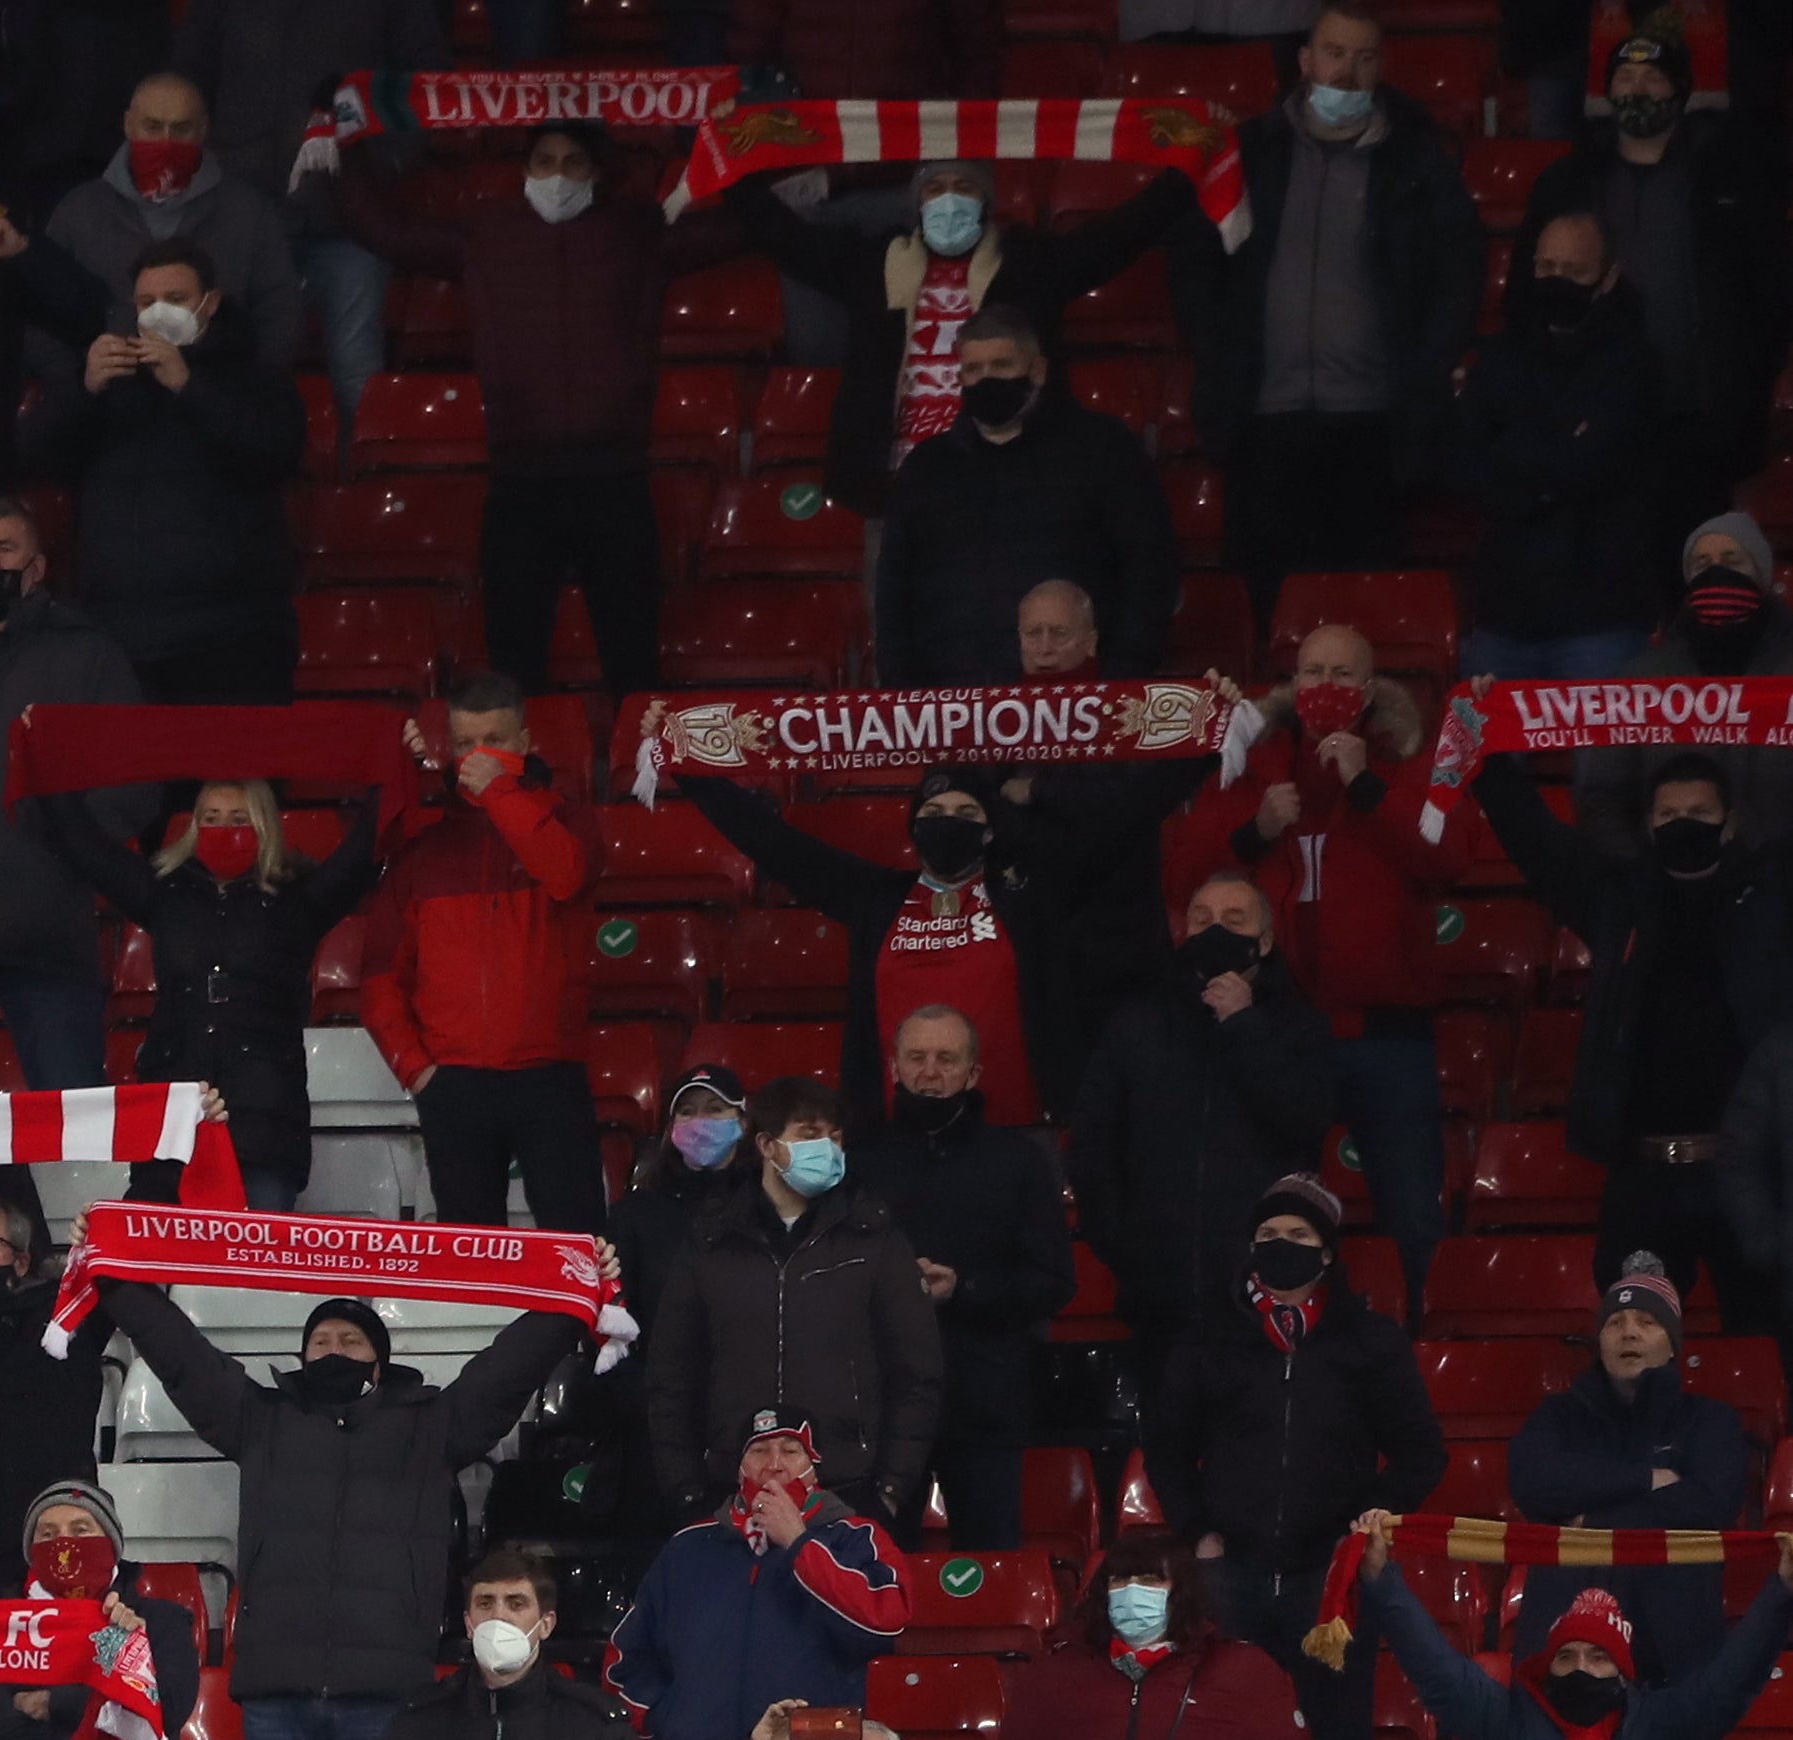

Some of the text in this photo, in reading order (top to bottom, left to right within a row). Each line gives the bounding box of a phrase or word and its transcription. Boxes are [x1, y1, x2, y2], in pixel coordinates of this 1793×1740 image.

[896, 688, 984, 705] LEAGUE
[1510, 683, 1752, 731] LIVERPOOL
[778, 696, 1103, 755] CHAMPIONS
[1524, 728, 1596, 749] YOU'LL
[1609, 726, 1674, 745] NEVER
[1692, 726, 1750, 745] WALK
[821, 744, 1063, 771] LIVERPOOL 2019/2020
[917, 916, 969, 934] Standard
[910, 934, 969, 952] Chartered
[124, 1213, 524, 1263] LIVERPOOL FOOTBALL CLUB
[225, 1247, 420, 1274] ESTABLISHED. 1892
[3, 1608, 59, 1650] FC
